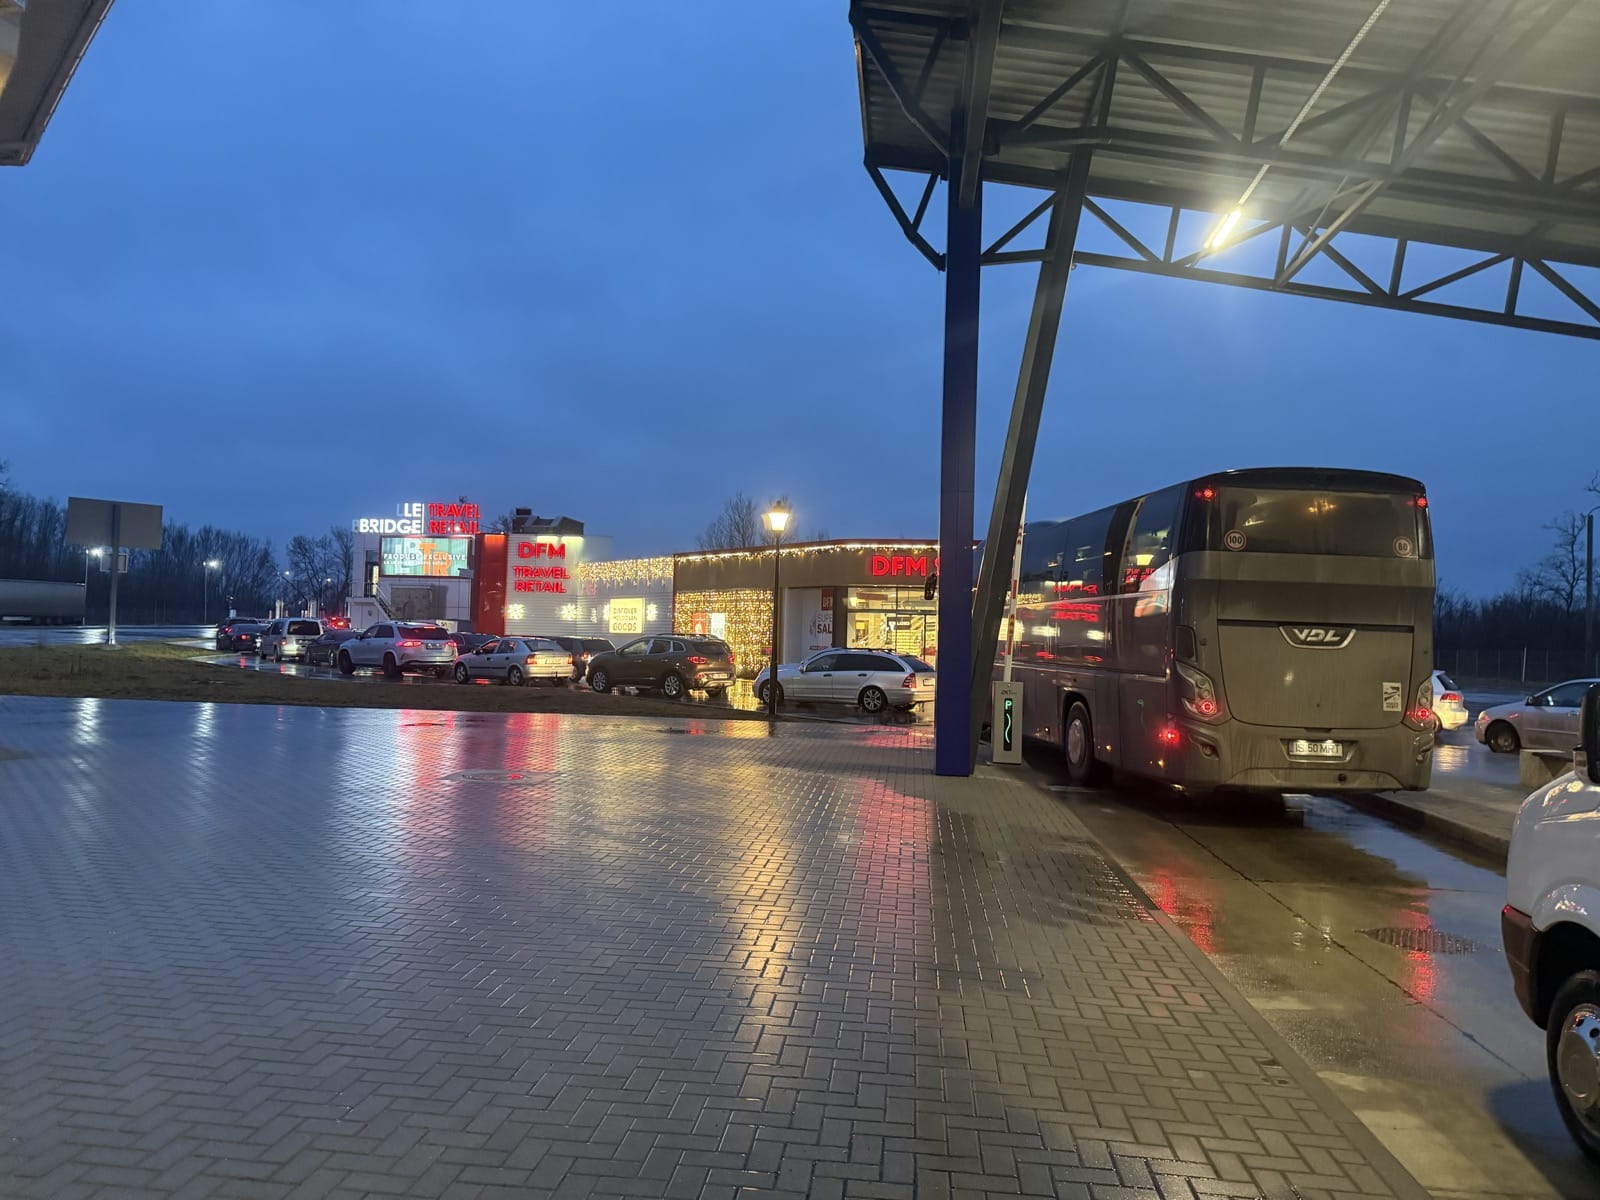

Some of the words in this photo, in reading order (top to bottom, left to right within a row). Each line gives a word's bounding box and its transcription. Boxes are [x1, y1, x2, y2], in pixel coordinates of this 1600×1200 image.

[403, 502, 422, 517] LE
[428, 502, 481, 518] TRAVEL
[359, 518, 422, 534] BRIDGE
[429, 519, 481, 535] RETAIL
[1229, 535, 1242, 545] 100
[518, 541, 566, 560] DFM
[512, 565, 571, 579] TRAVEL
[872, 555, 927, 576] DFM
[515, 580, 568, 593] RETAIL
[612, 622, 637, 631] GOODS
[817, 623, 833, 634] SAL
[1292, 628, 1341, 642] VDL
[1307, 743, 1318, 753] 50
